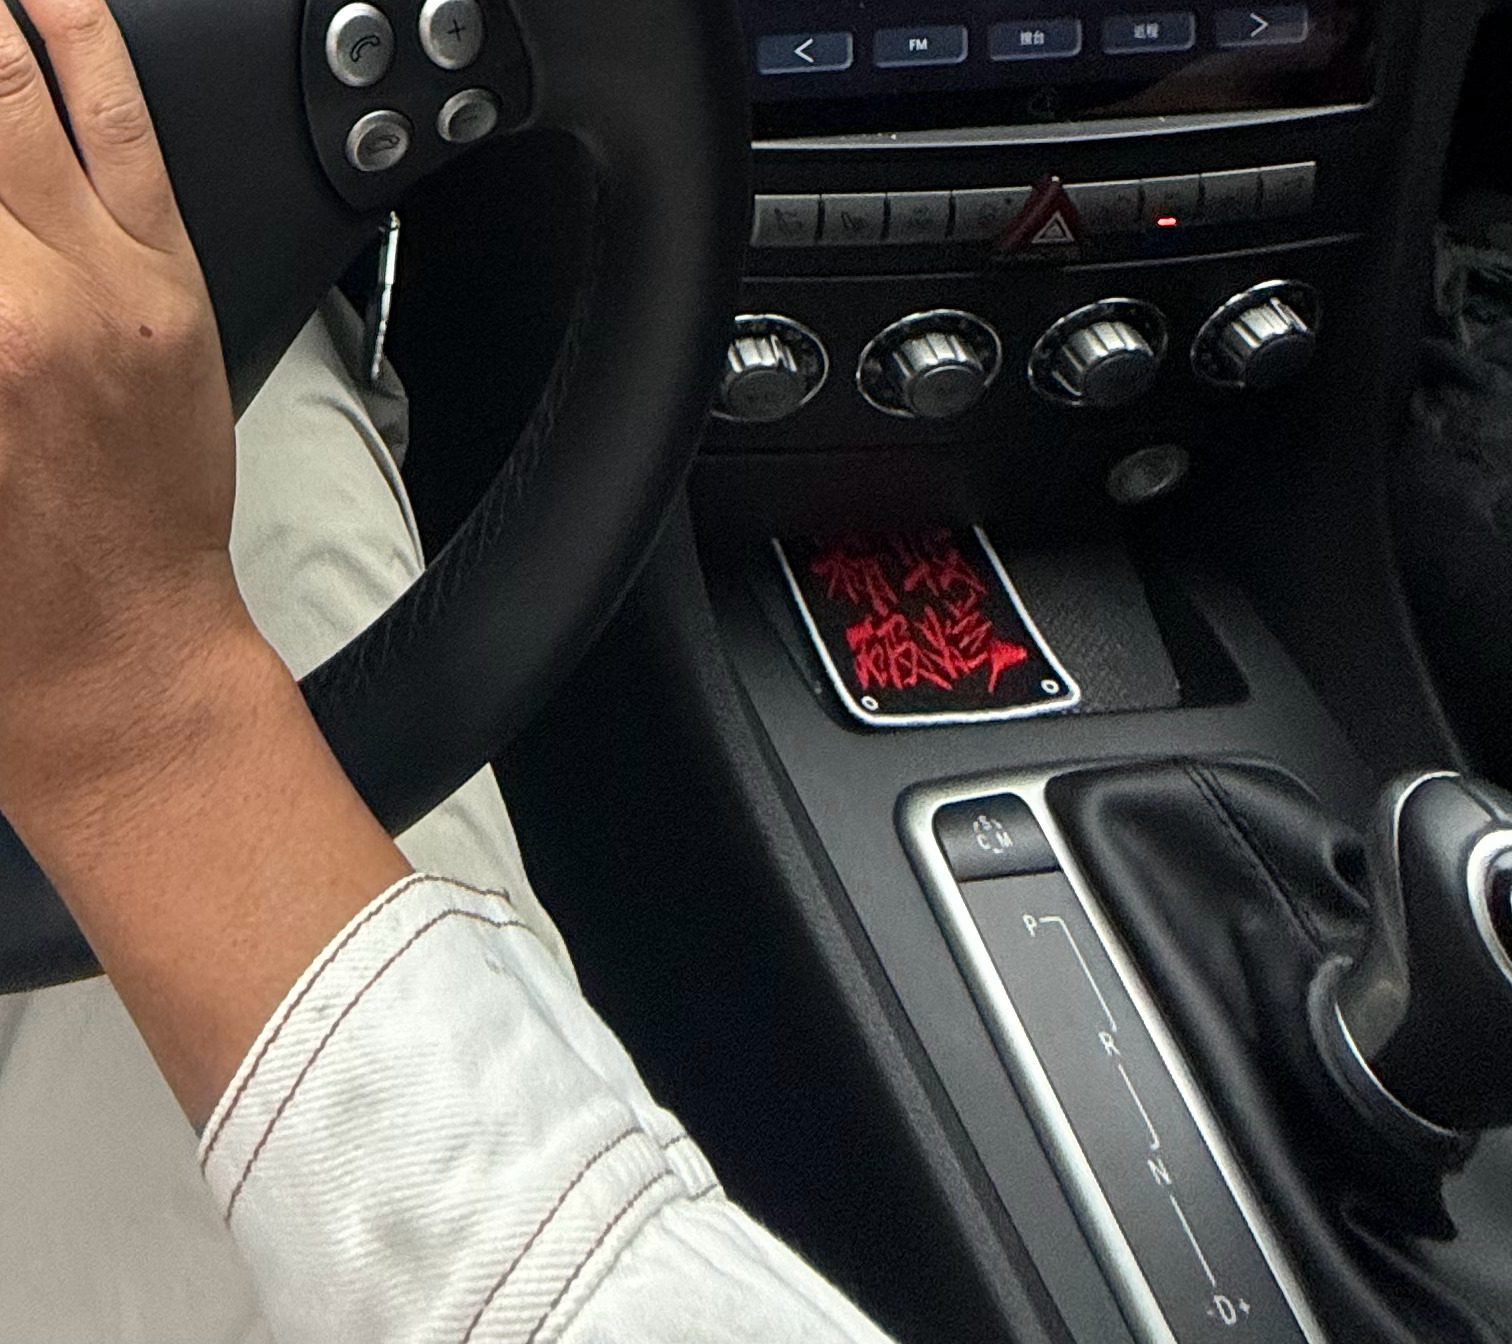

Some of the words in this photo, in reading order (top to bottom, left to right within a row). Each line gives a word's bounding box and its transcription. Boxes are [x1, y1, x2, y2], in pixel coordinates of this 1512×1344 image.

[908, 37, 928, 52] FM
[1022, 914, 1038, 938] P
[1098, 1031, 1121, 1056] R
[1147, 1159, 1172, 1186] N
